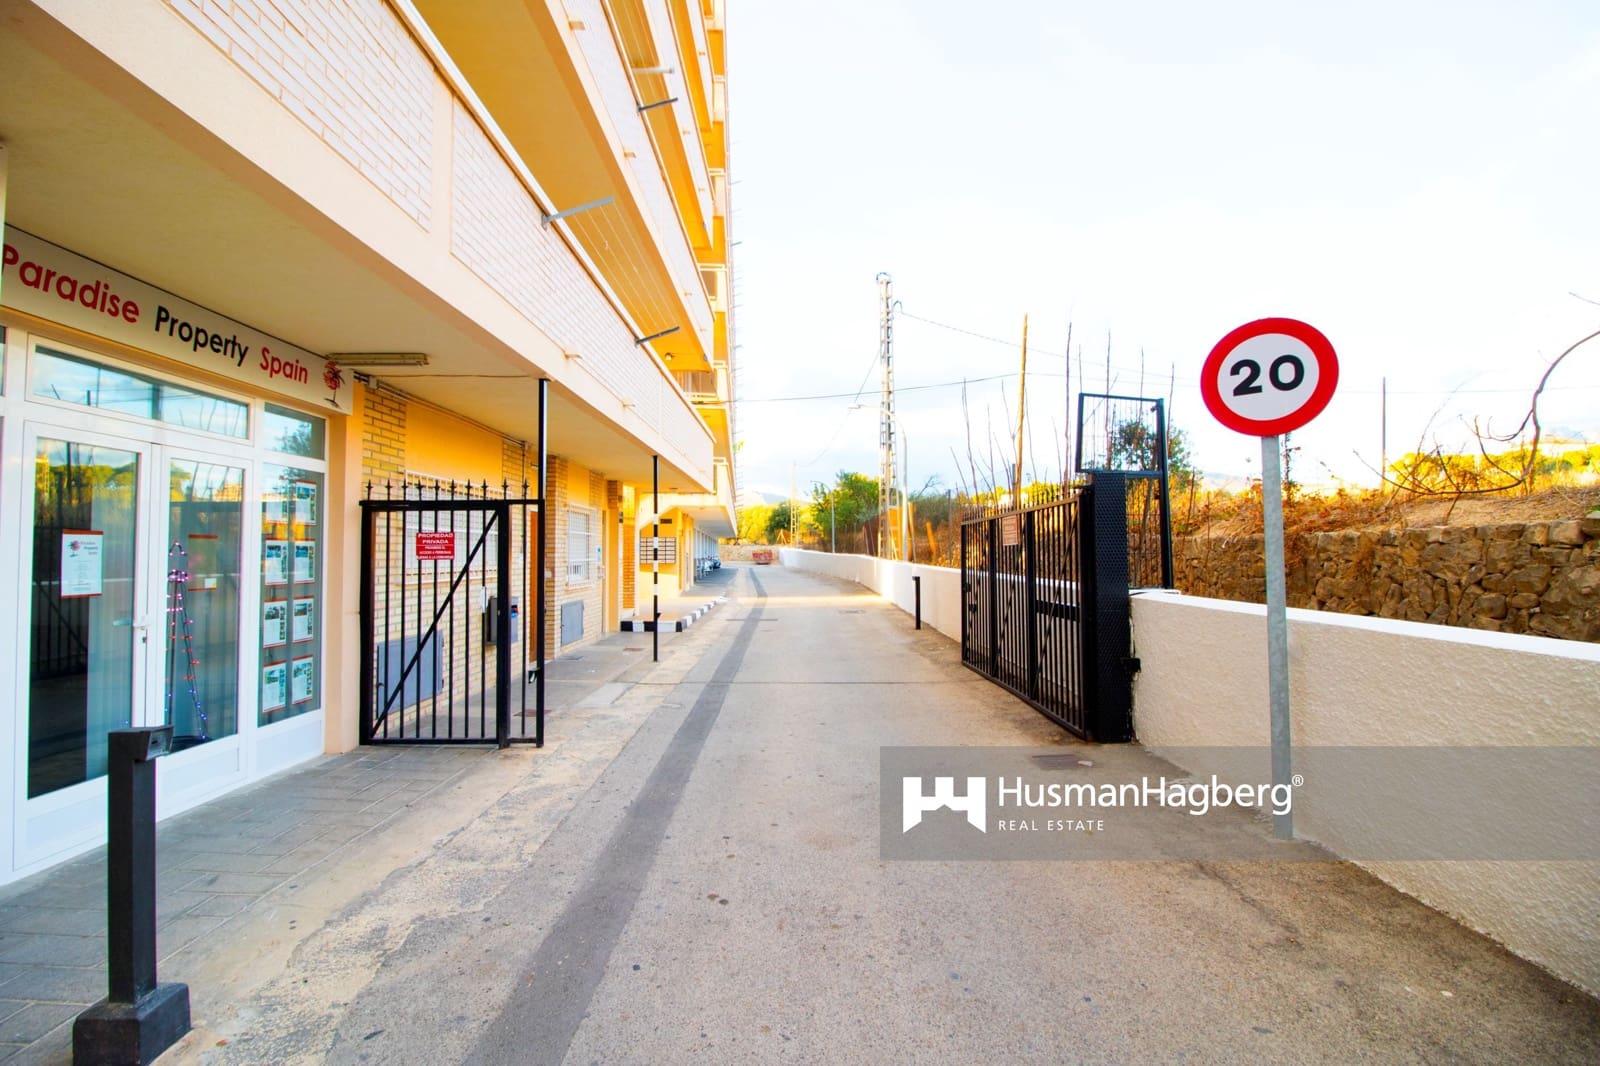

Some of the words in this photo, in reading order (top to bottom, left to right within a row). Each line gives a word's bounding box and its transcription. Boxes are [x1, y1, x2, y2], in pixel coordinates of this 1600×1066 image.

[2, 243, 140, 323] Paradise
[154, 305, 249, 367] Property
[259, 346, 309, 385] Spain
[1230, 354, 1305, 397] 20
